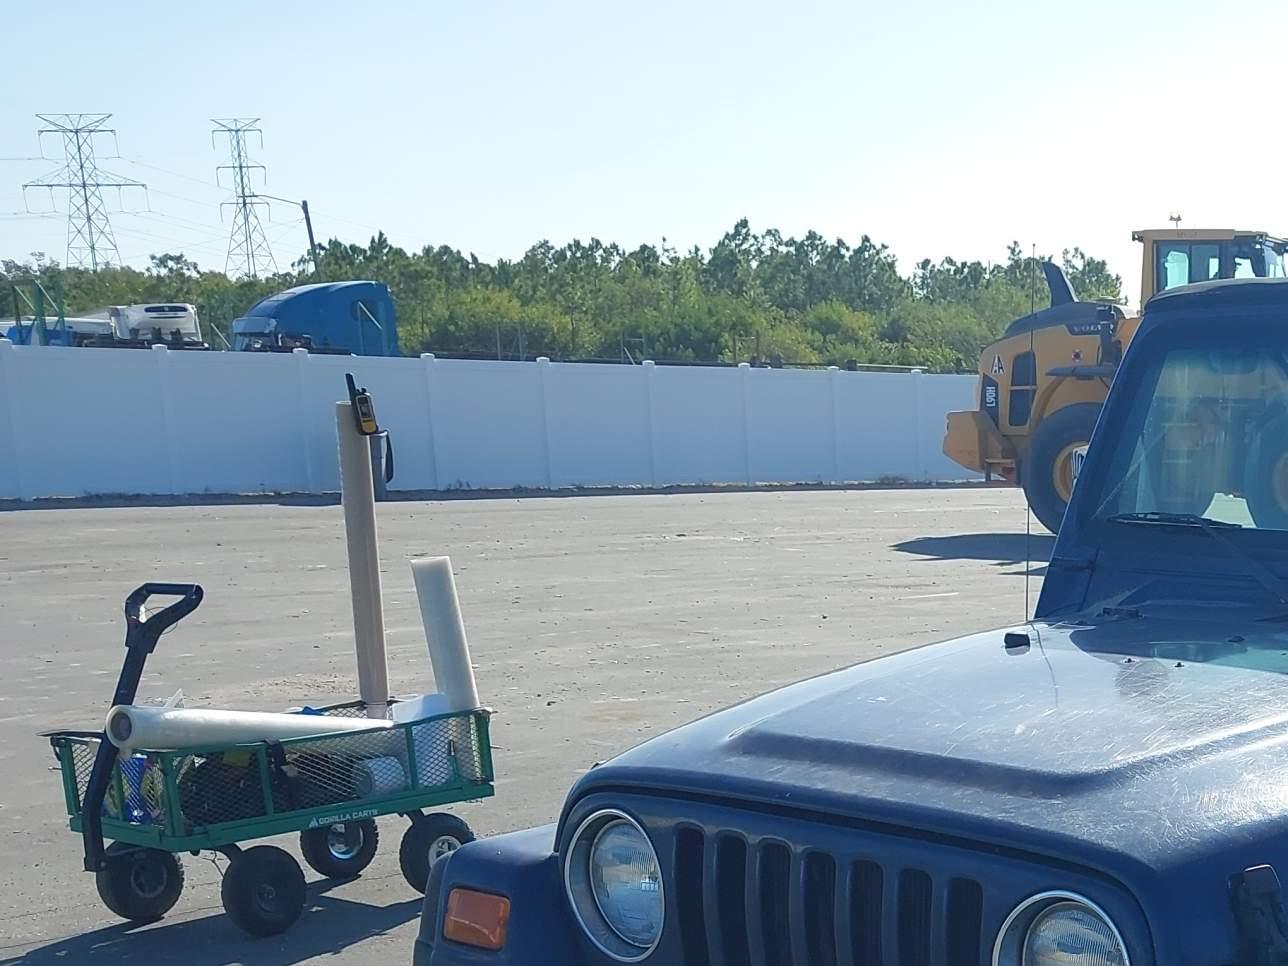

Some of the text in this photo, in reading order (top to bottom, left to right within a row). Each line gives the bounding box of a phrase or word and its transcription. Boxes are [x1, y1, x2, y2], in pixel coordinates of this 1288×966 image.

[985, 386, 996, 407] L90H
[318, 809, 378, 825] GORILLA CARTS
